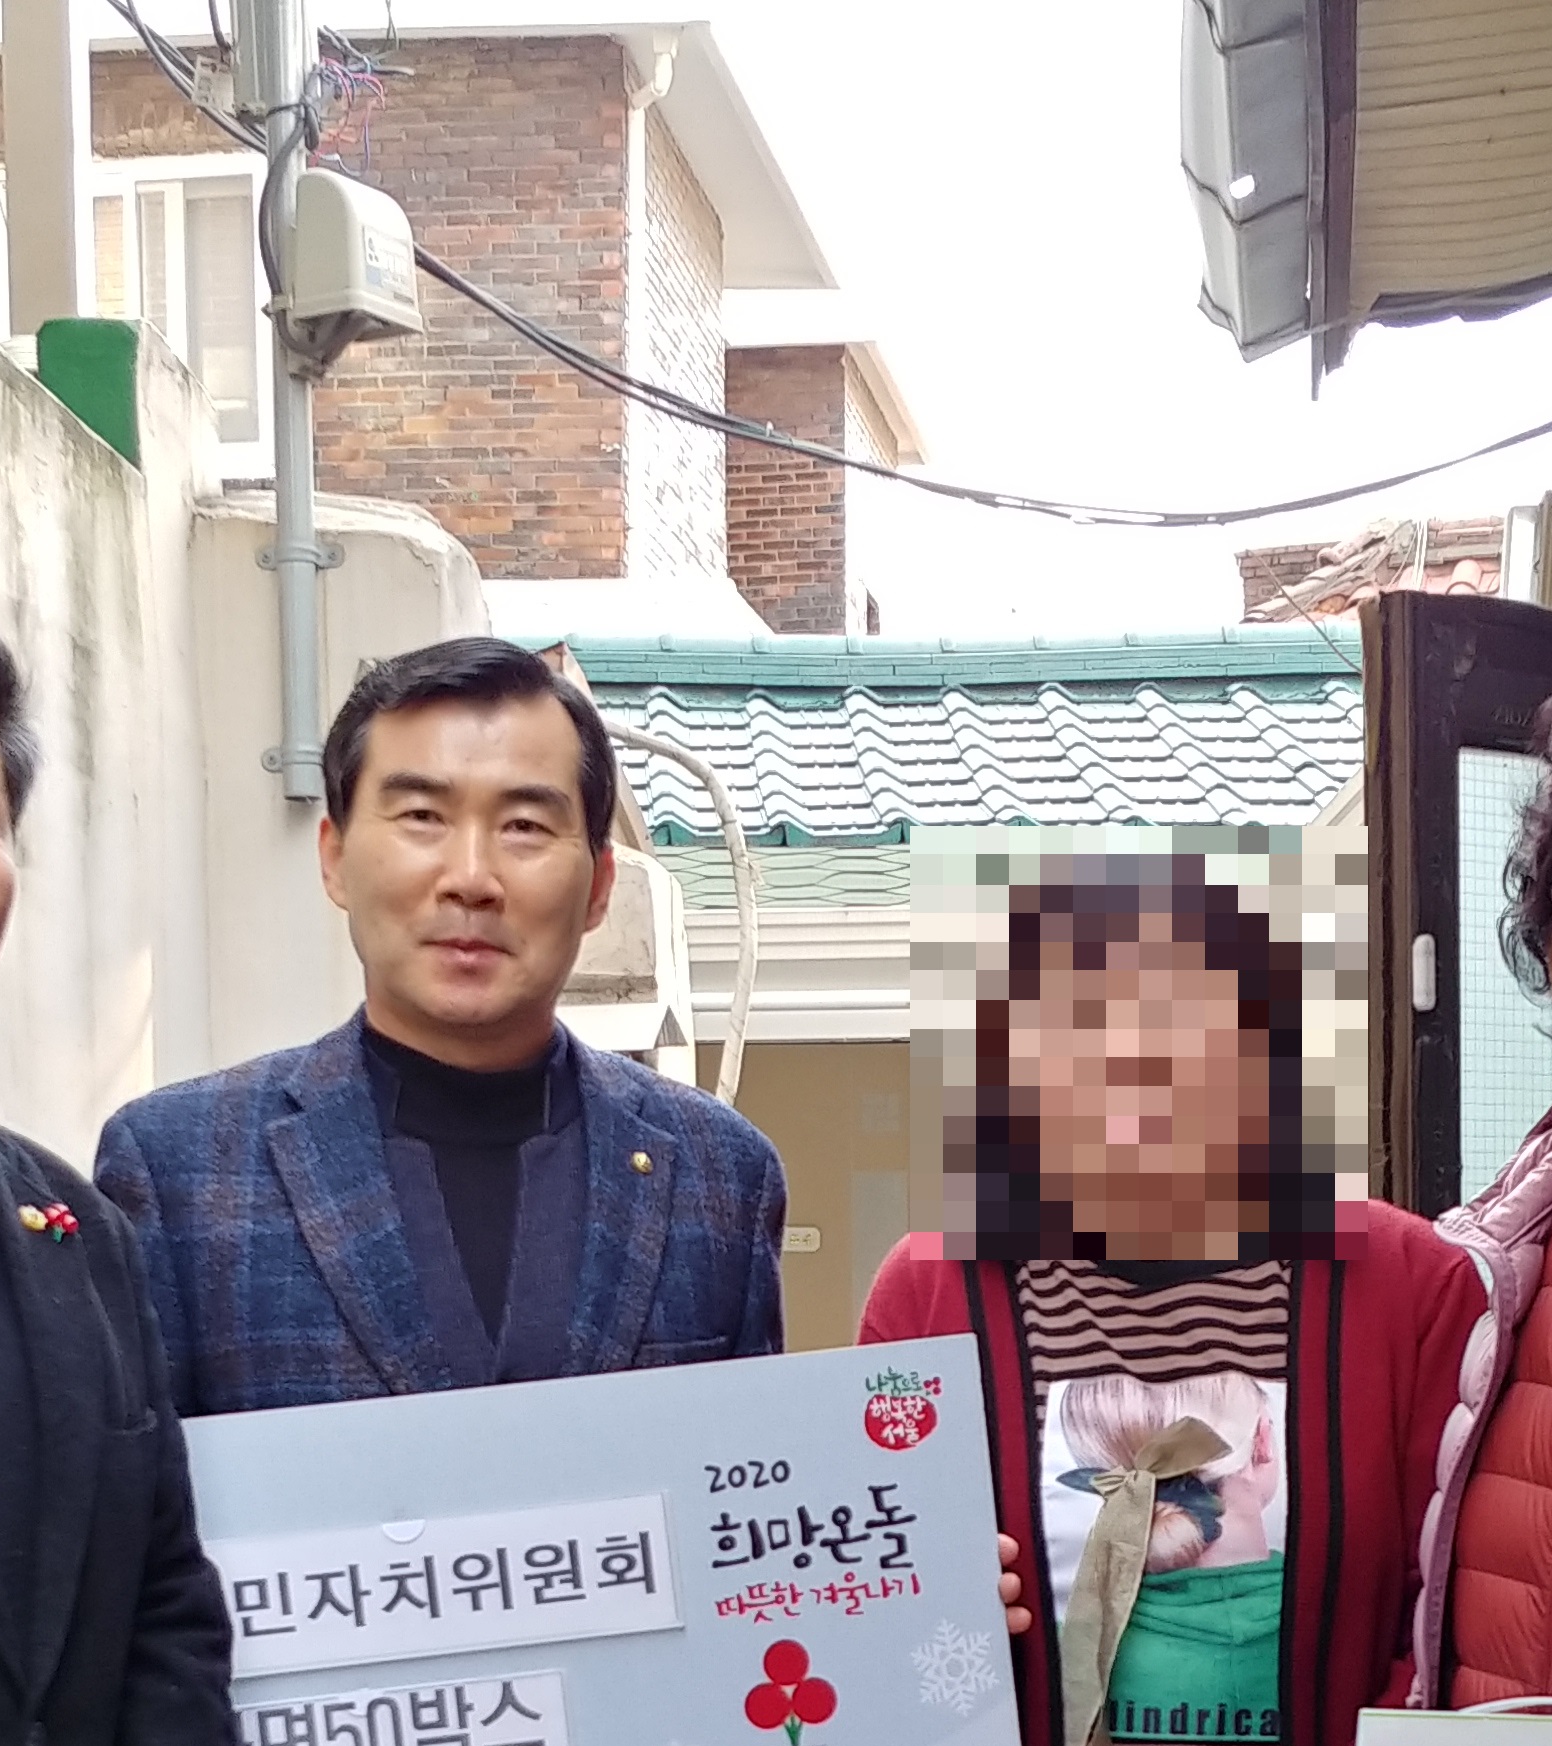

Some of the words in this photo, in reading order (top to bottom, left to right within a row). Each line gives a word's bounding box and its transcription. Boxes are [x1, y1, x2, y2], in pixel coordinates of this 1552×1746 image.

[865, 1366, 923, 1396] 나눔으로
[869, 1395, 927, 1424] 행복한
[880, 1418, 920, 1446] 서울
[704, 1460, 791, 1493] 2020
[710, 1483, 917, 1569] 희망온돌
[233, 1530, 657, 1637] 민자치위원회
[715, 1581, 804, 1624] 따뜻한
[809, 1572, 921, 1615] 겨울나기
